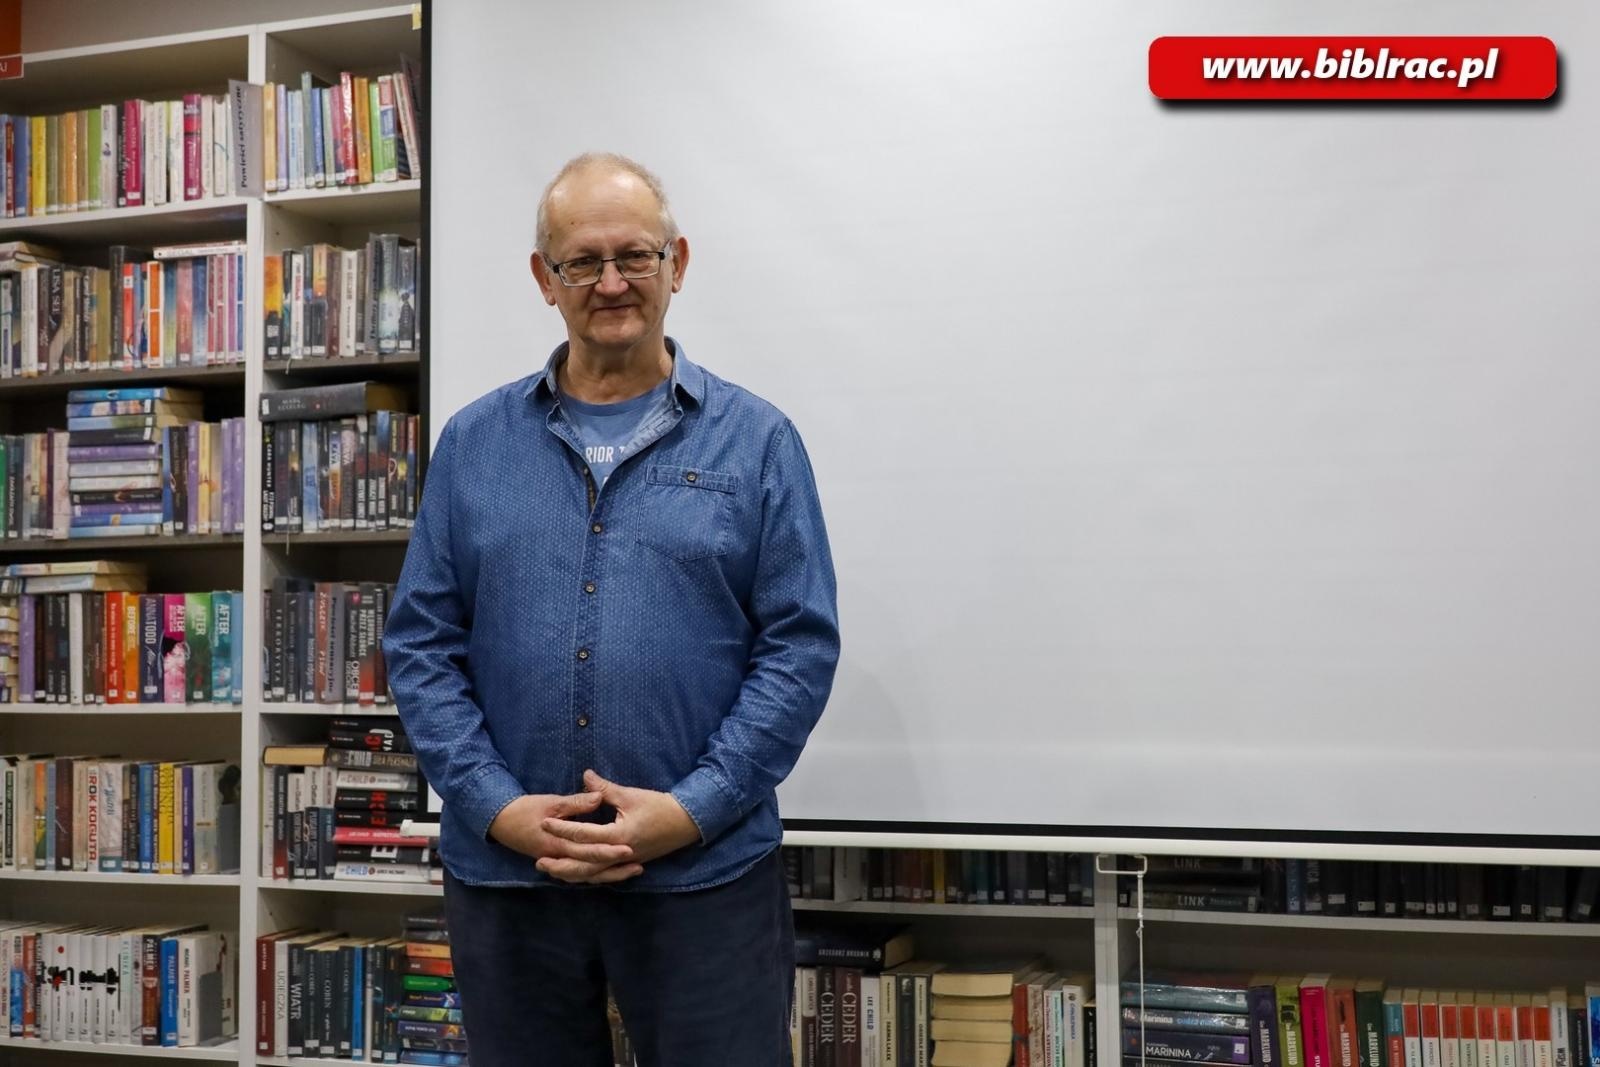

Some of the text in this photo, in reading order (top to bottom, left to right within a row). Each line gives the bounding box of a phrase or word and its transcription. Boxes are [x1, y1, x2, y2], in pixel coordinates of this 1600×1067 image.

[145, 621, 156, 645] TODD
[176, 605, 185, 632] AFTER
[196, 605, 207, 635] AFTER
[219, 604, 230, 634] AFTER
[275, 608, 283, 682] TERRORYSTA
[351, 660, 361, 689] OBCE
[88, 775, 98, 861] ROK KOGUTA
[1174, 858, 1201, 870] LINK
[1177, 895, 1205, 907] LINK
[121, 941, 129, 976] KLINIKA
[146, 938, 156, 970] PALMER
[167, 955, 176, 985] PALMER
[183, 970, 191, 993] PALMER
[276, 971, 286, 1020] UCIECZKA
[323, 979, 332, 1008] COBEN
[290, 983, 302, 1020] WIATR
[820, 992, 835, 1043] CEDER
[842, 992, 857, 1043] CEDER
[1146, 1046, 1192, 1059] MARININA
[1260, 1028, 1272, 1063] MARKLUND
[1286, 1031, 1298, 1065] MARKLUND
[1341, 1032, 1352, 1067] MARKLUND
[1368, 1031, 1380, 1067] MARKLUND
